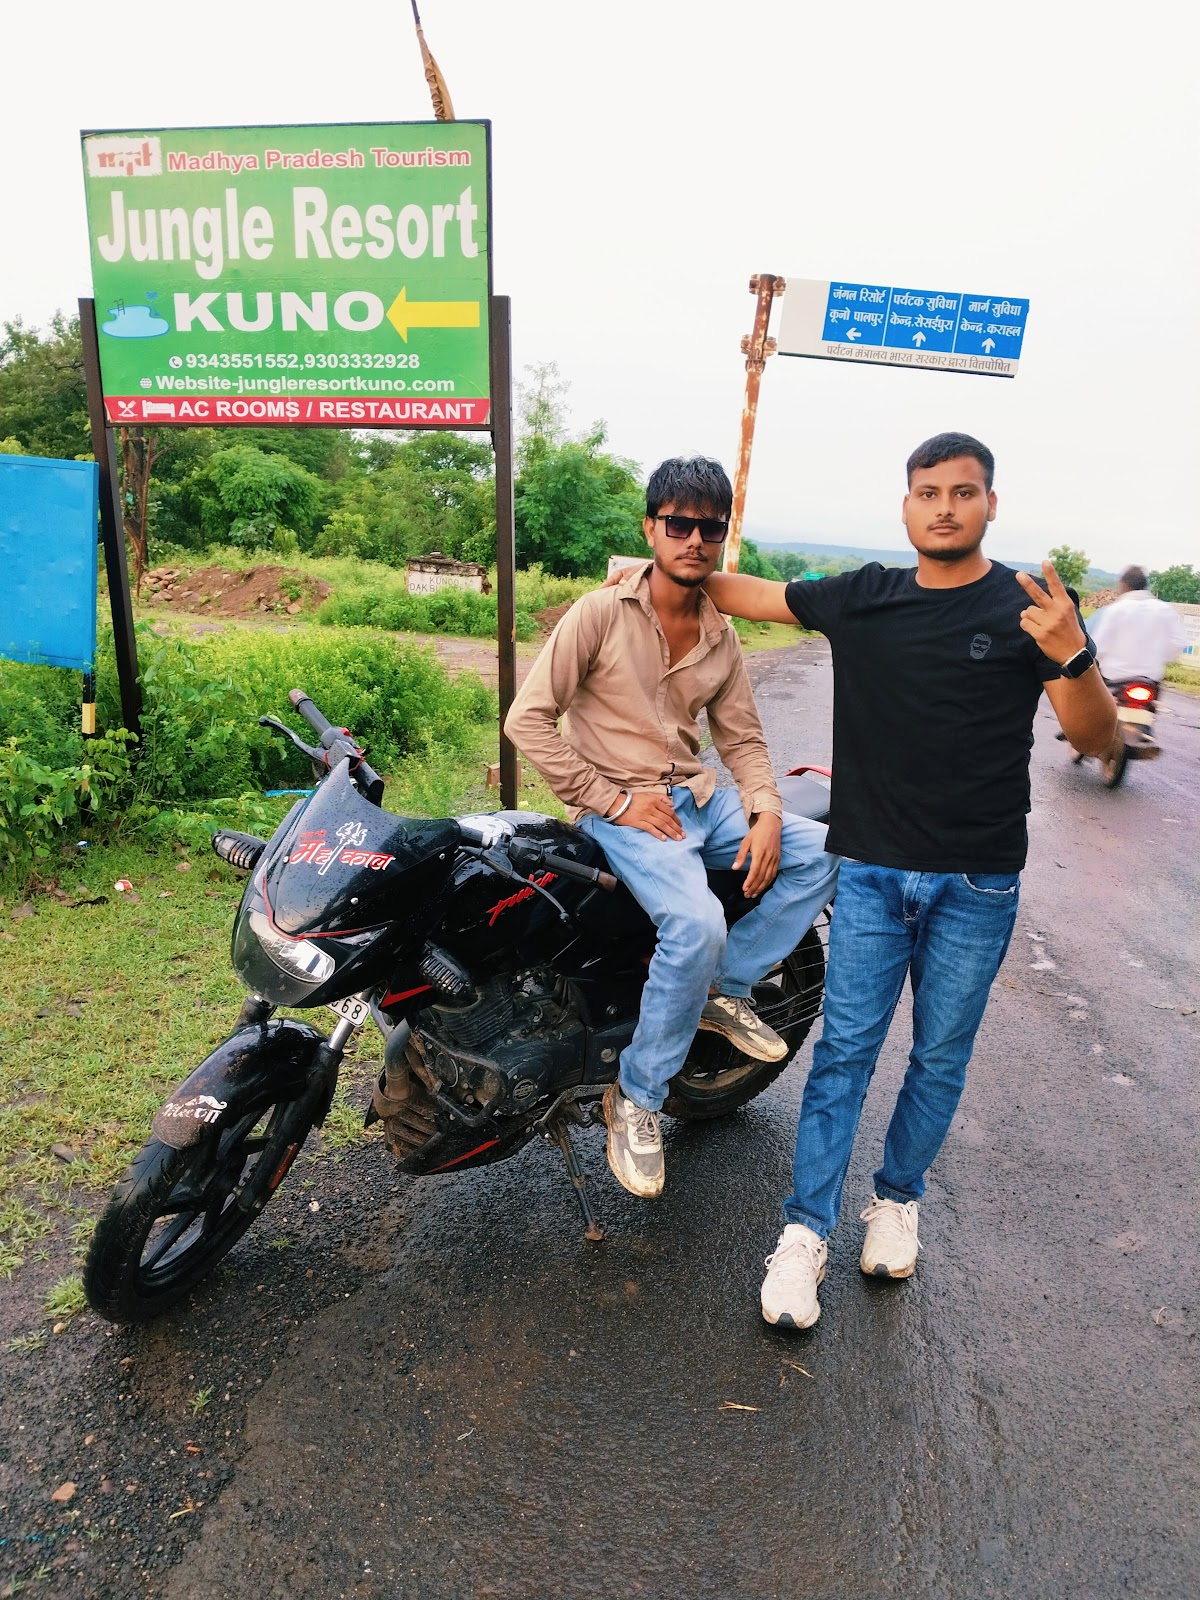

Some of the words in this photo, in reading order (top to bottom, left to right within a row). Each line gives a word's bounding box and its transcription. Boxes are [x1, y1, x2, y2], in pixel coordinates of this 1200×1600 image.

[167, 151, 259, 175] Madhya
[265, 148, 365, 169] Pradesh
[370, 147, 471, 167] Tourism
[97, 187, 274, 280] Jungle
[293, 185, 479, 259] Resort
[833, 285, 857, 301] जंगल
[859, 287, 887, 304] रिसोर्ट
[893, 292, 925, 307] पर्यटक
[925, 294, 958, 311] सुविधा
[173, 290, 385, 332] KUNO
[829, 306, 851, 323] कूनो
[853, 311, 884, 327] पालपुर
[968, 299, 991, 313] मार्ग
[991, 300, 1022, 318] सुविधा
[185, 353, 420, 370] 9343551552,9303332928
[826, 343, 854, 357] पर्यटन
[854, 346, 888, 360] मंत्रालय
[889, 352, 913, 362] भारत
[915, 354, 947, 366] सरकार
[155, 375, 455, 394] Website-jungleresortkuno.com
[178, 400, 210, 417] AC
[216, 401, 300, 418] ROOMS
[319, 402, 476, 420] RESTAURANT
[409, 582, 428, 592] DAK
